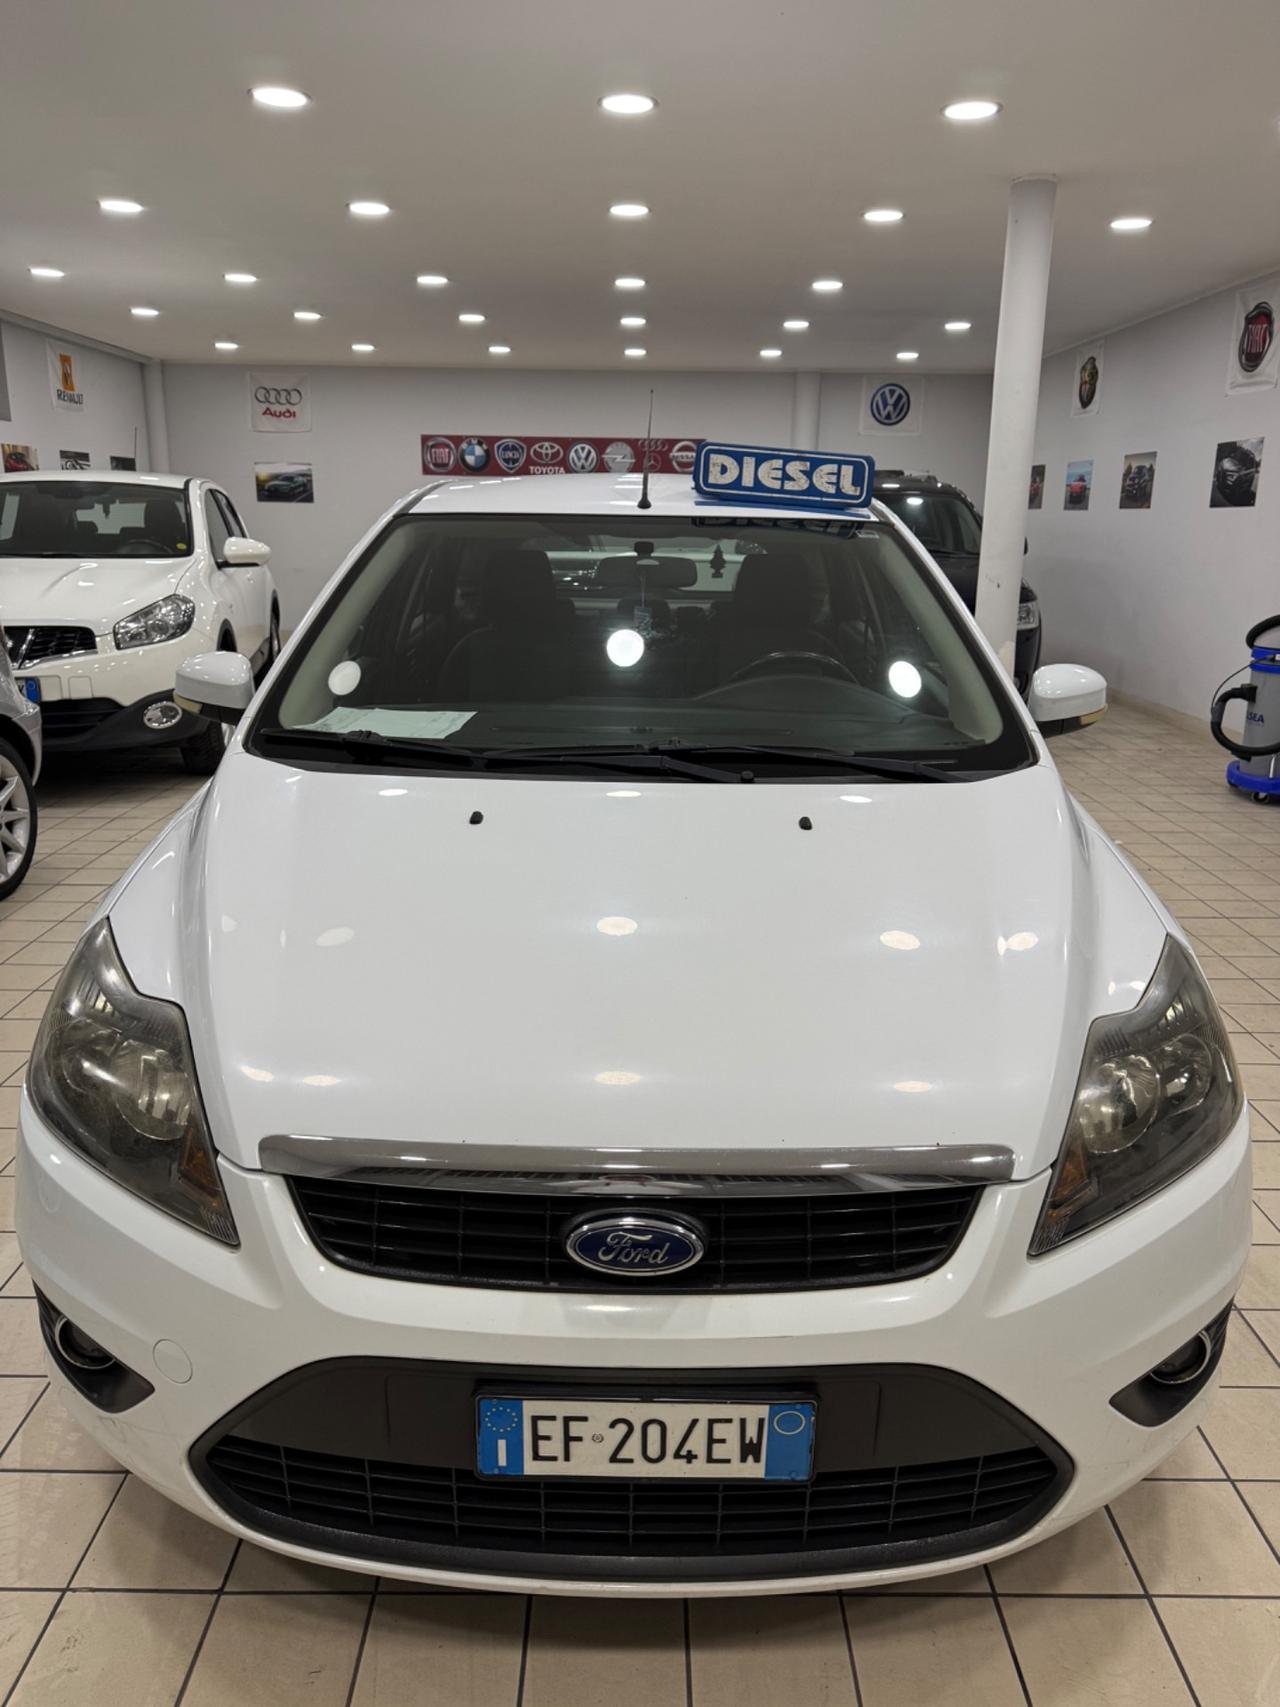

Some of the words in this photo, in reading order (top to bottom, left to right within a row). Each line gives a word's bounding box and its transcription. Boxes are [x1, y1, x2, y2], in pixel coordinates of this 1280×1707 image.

[1248, 324, 1268, 353] FIAT
[262, 407, 296, 419] Audi
[431, 448, 449, 463] FIAT
[529, 466, 565, 475] TOYOTA
[708, 453, 861, 496] DIESEL
[597, 1231, 670, 1264] Ford
